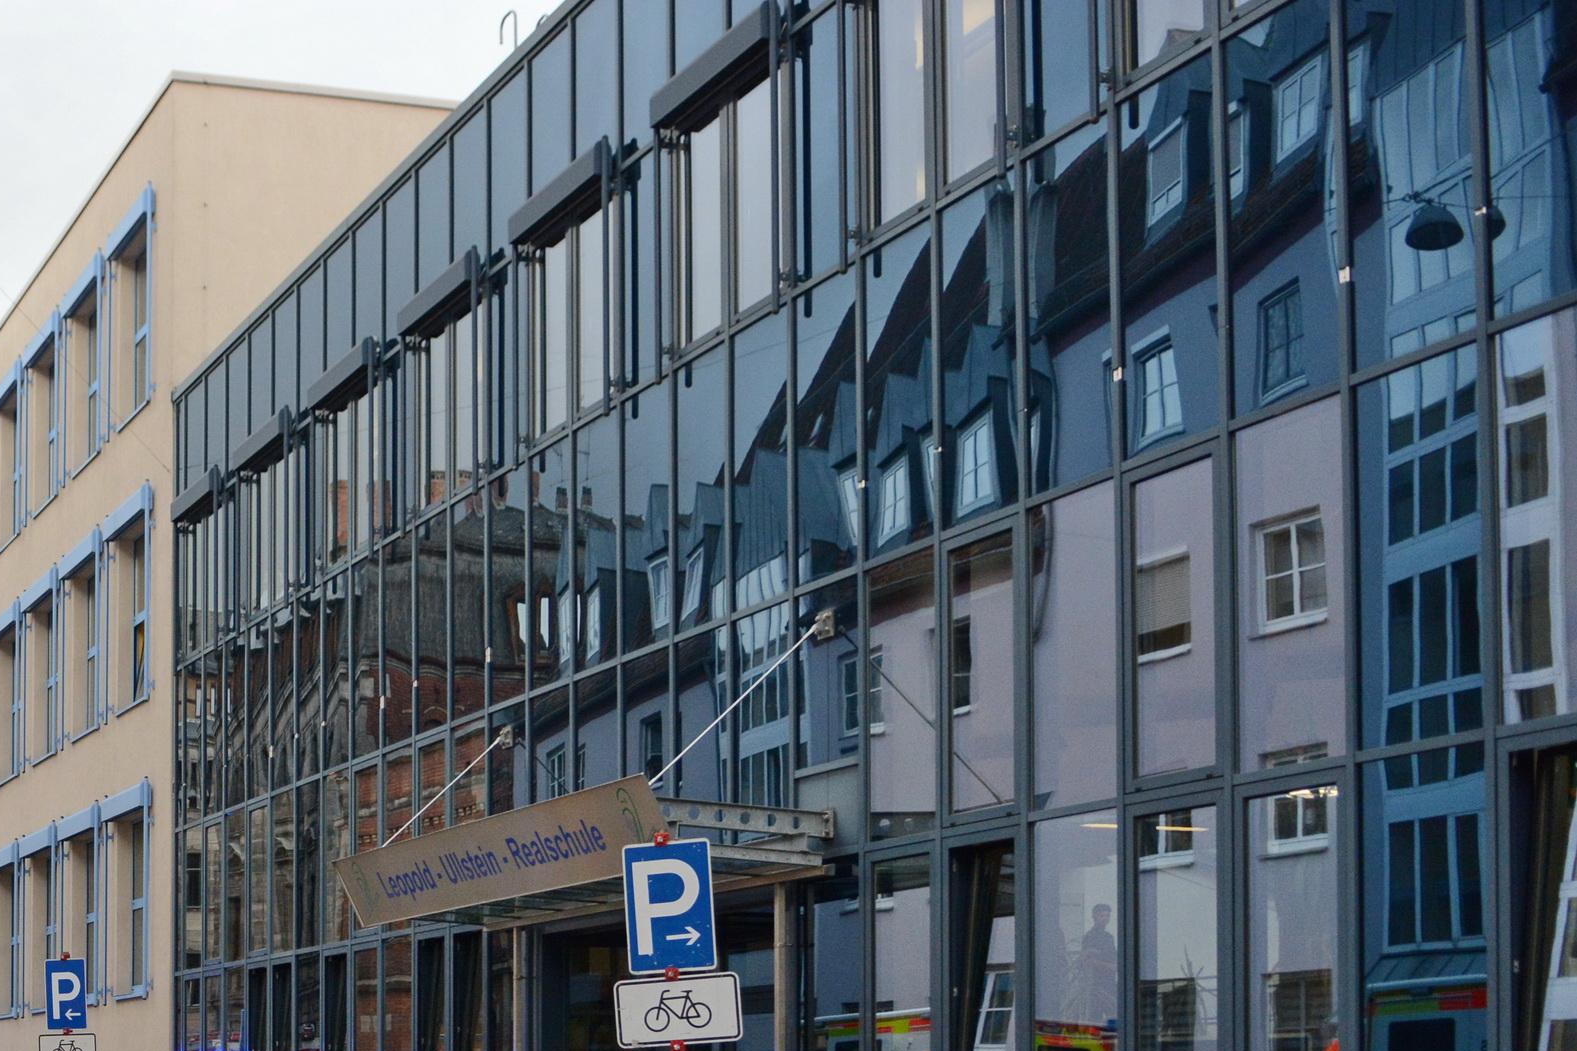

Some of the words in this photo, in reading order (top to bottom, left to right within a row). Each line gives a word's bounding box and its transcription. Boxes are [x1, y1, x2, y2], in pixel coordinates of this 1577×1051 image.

[376, 860, 438, 901] Leopold
[439, 846, 502, 884] Ullstein
[505, 819, 606, 869] Realschule
[632, 859, 700, 956] P
[51, 972, 81, 1020] P
